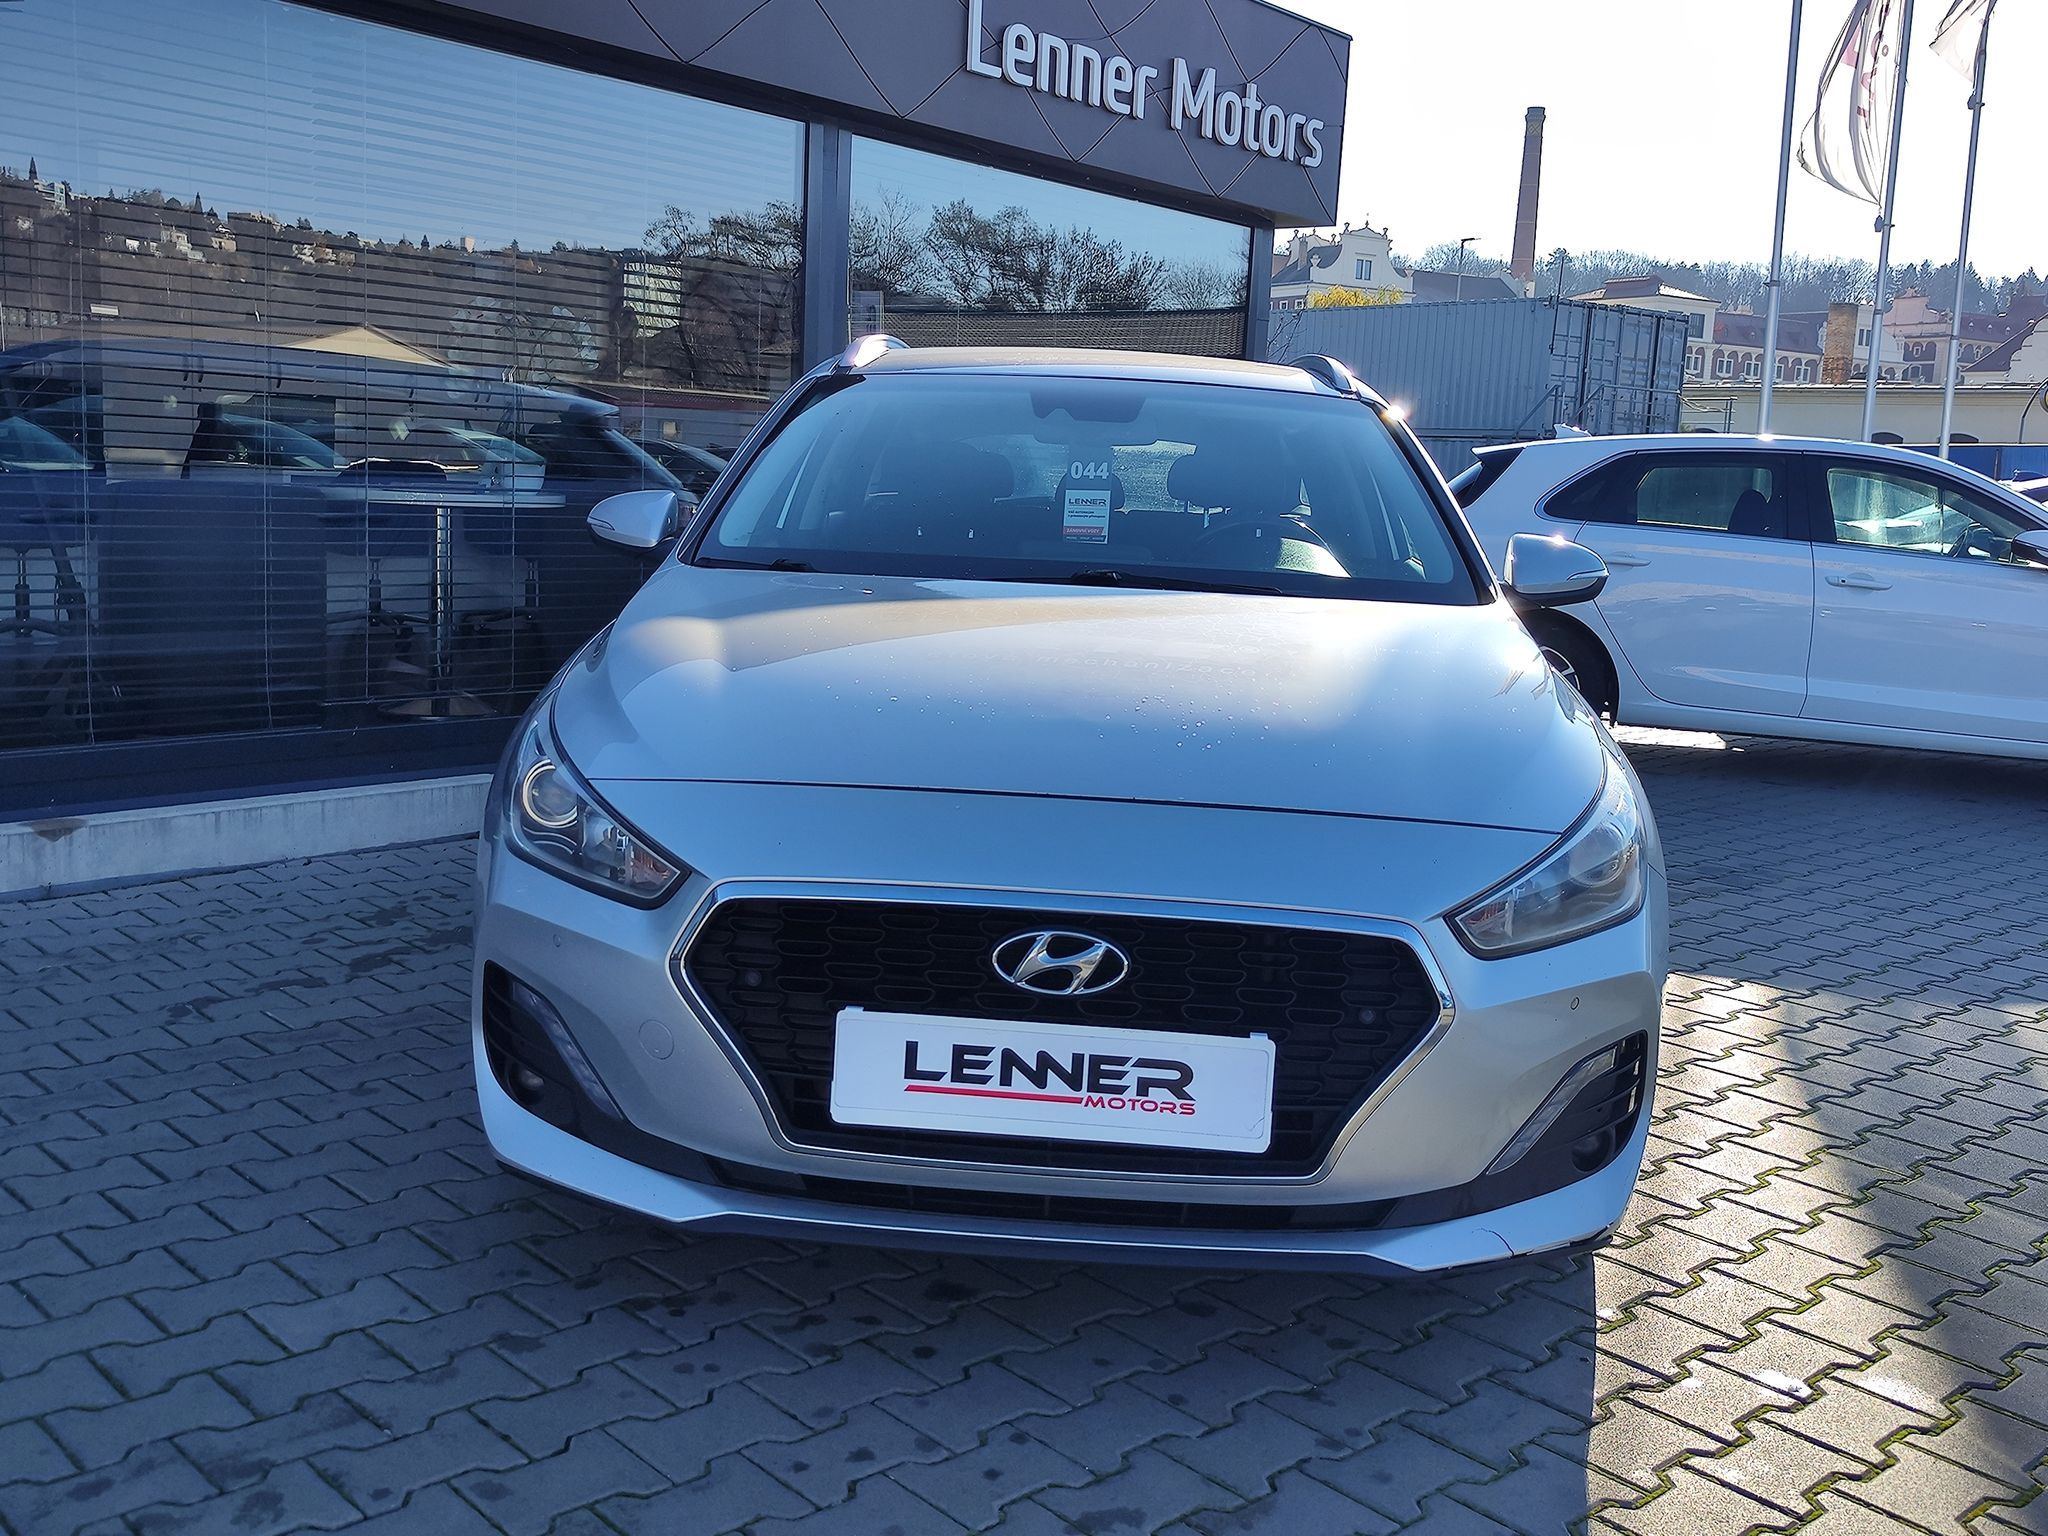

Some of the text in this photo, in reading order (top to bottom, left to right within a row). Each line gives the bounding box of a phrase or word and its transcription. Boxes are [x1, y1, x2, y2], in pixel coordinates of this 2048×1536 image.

[966, 0, 1324, 167] Lenner Motors
[1070, 461, 1109, 480] 044
[1068, 497, 1107, 507] LENNER
[904, 1040, 1196, 1101] LENNER
[1084, 1094, 1196, 1116] MOTORS
